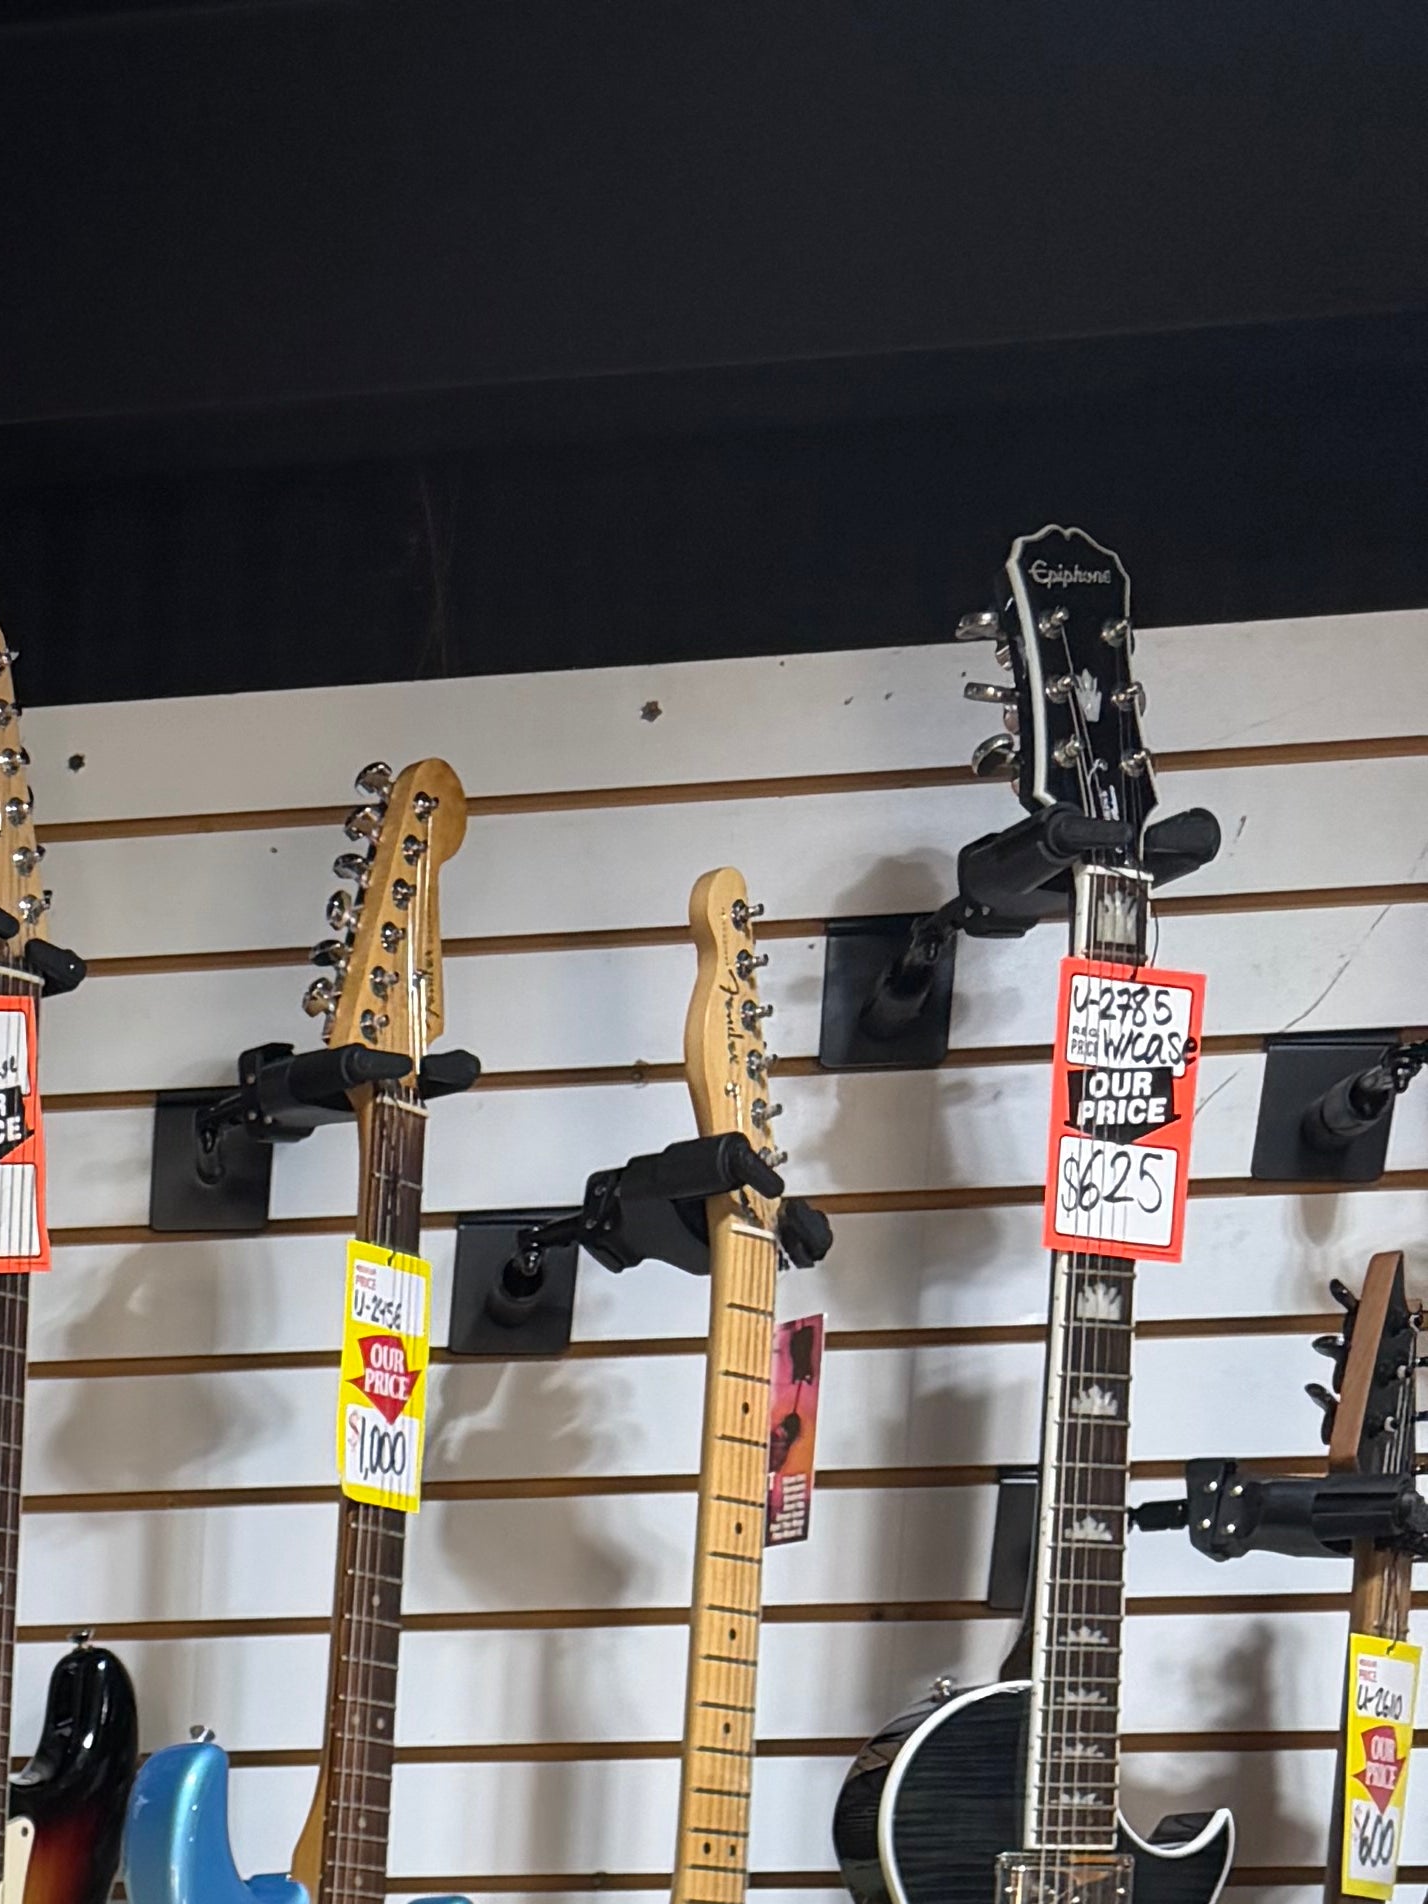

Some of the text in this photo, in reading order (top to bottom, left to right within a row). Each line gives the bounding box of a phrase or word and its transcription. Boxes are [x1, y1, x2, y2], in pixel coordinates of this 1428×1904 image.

[1028, 559, 1111, 589] Epiphone
[719, 969, 744, 1066] Fender
[1074, 983, 1172, 1028] U-2785
[1071, 1038, 1098, 1056] PRICE
[1089, 1071, 1153, 1098] OUR
[1076, 1097, 1168, 1125] PRICE
[1061, 1149, 1164, 1218] $625
[370, 1342, 405, 1374] OUR
[365, 1371, 410, 1402] PRICE
[347, 1409, 407, 1481] $1,000
[1370, 1735, 1395, 1762] OUR
[1365, 1760, 1398, 1790] PRICE
